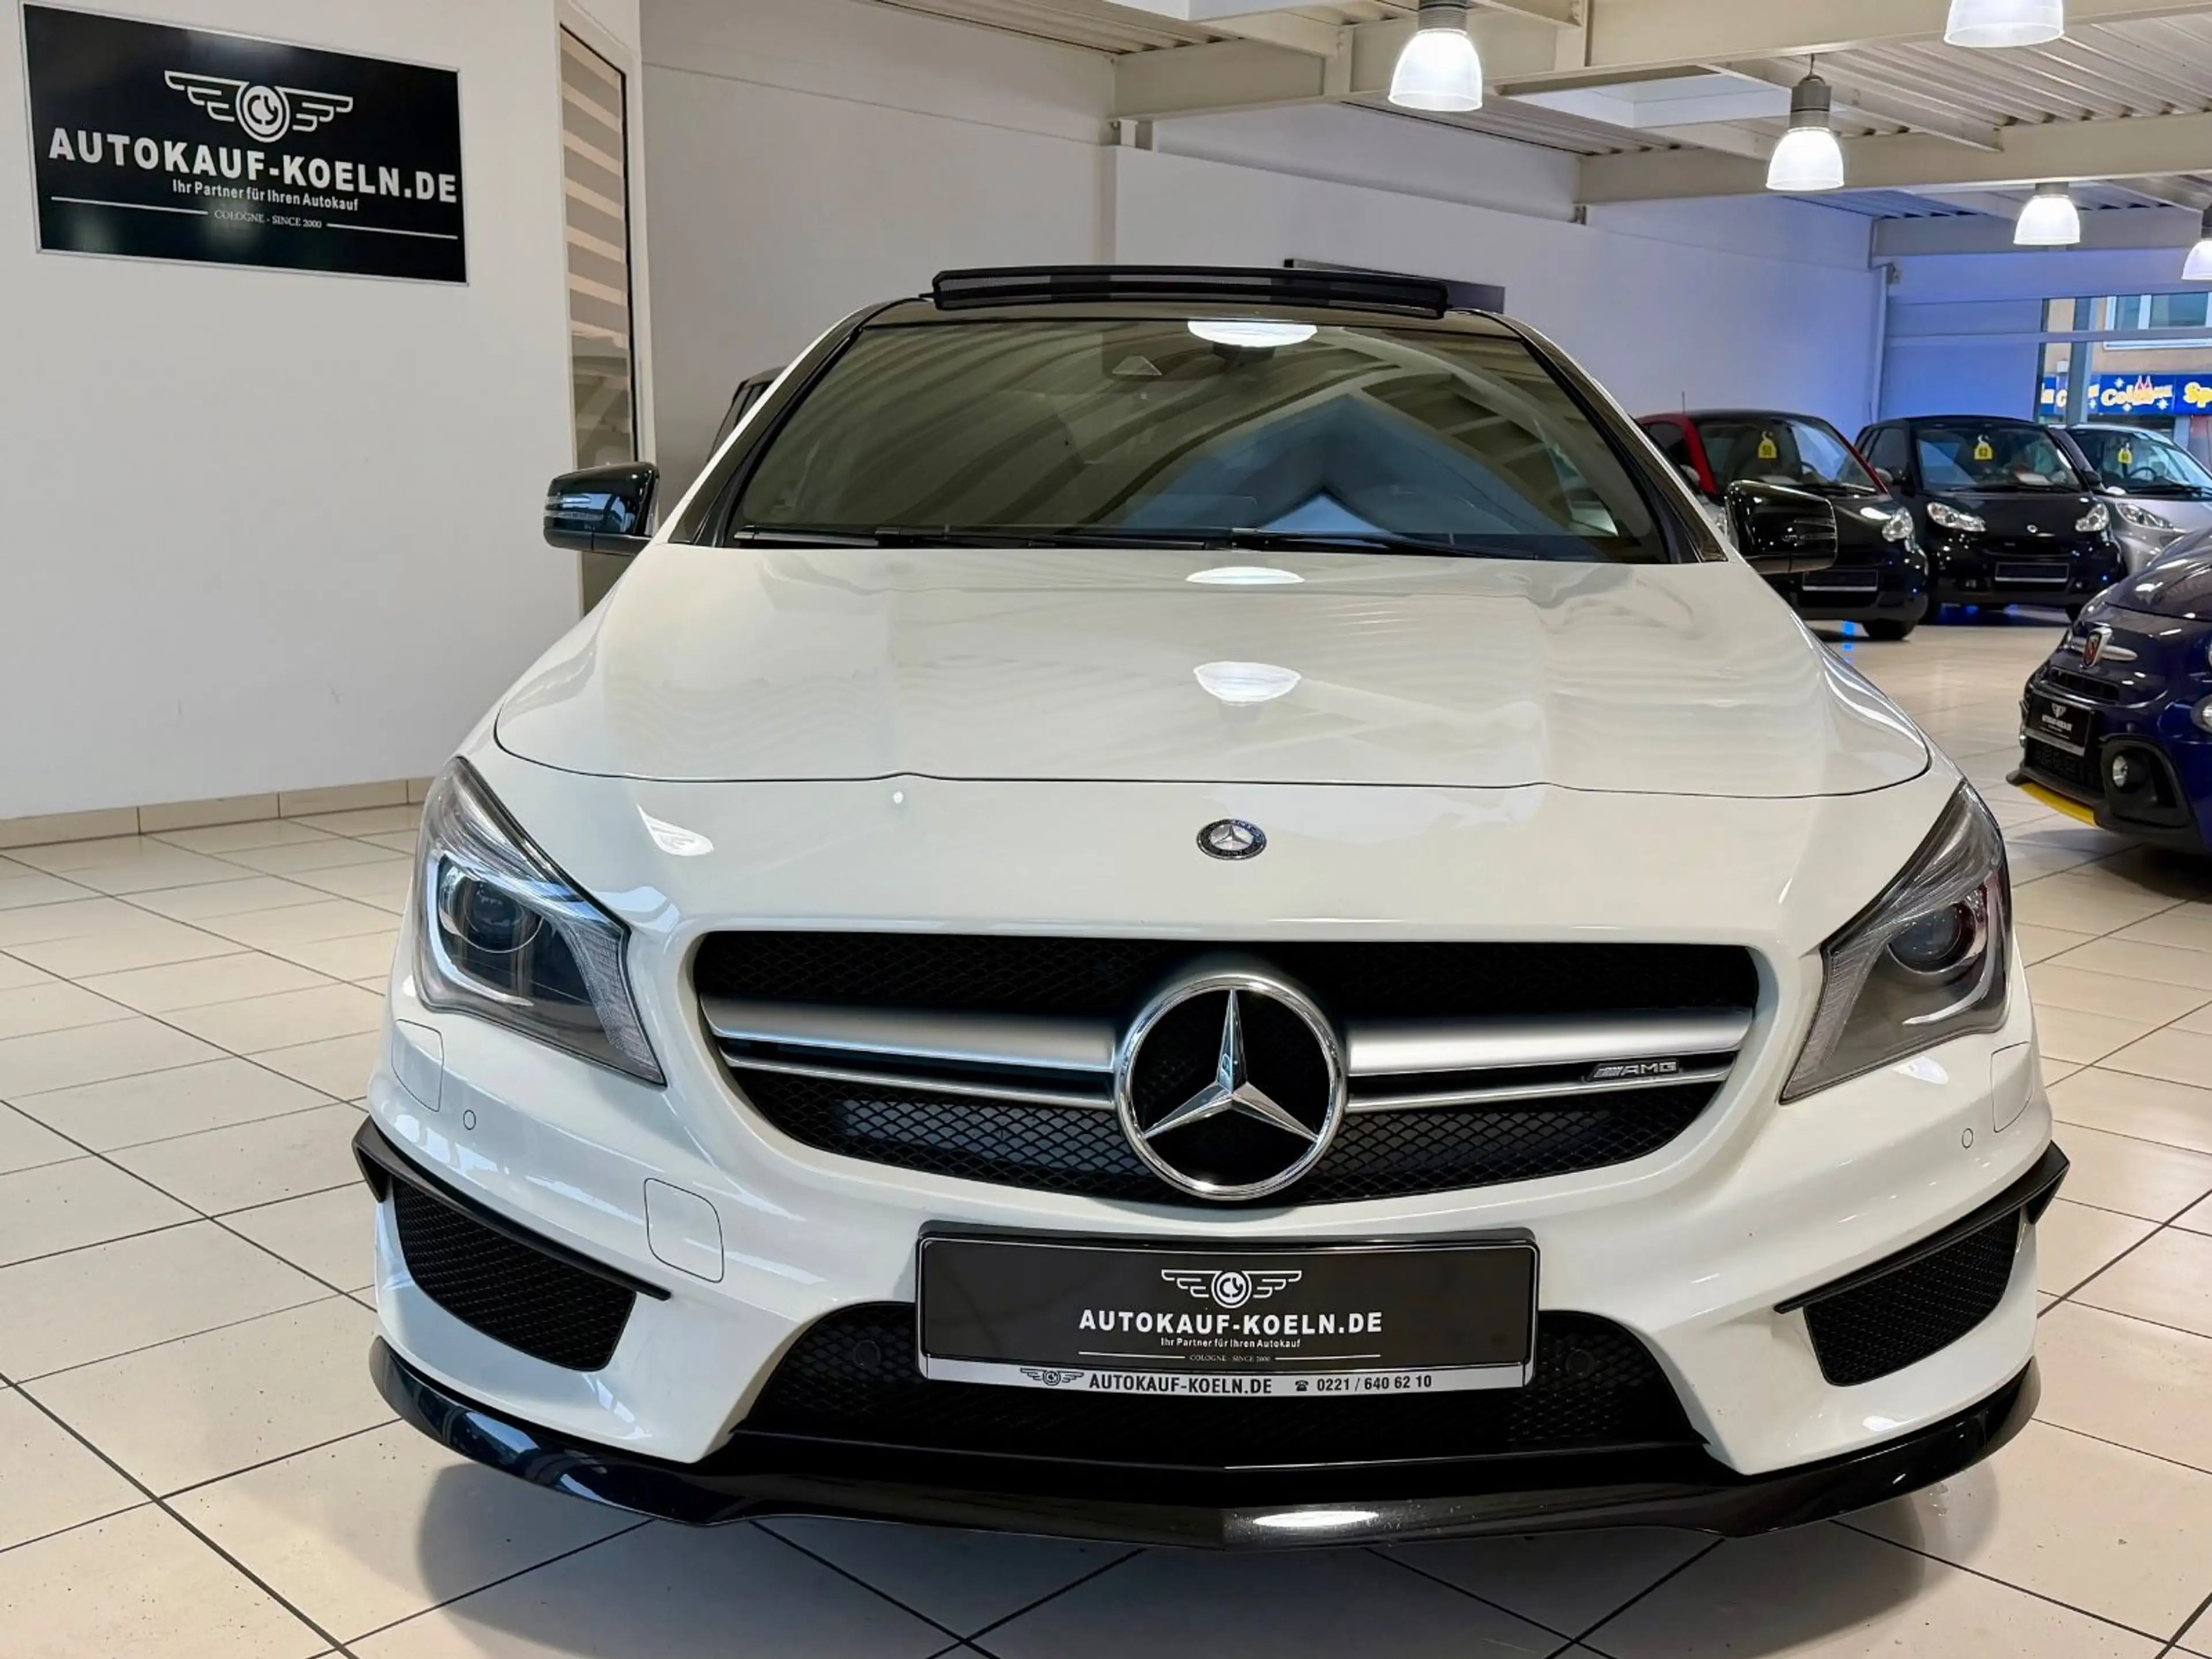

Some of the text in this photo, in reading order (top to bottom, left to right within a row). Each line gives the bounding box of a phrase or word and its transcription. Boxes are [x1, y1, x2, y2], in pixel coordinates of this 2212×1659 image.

[48, 127, 457, 203] AUTOKAUF-KOELN.DE
[173, 179, 358, 211] Ihr Partner für Ihren Autokauf
[214, 210, 265, 223] COLOGNE
[272, 215, 301, 226] SINCE
[303, 219, 322, 228] 2000
[1078, 1309, 1382, 1335] AUTOKAUF-KOELN.DE
[1161, 1337, 1301, 1348] Ihr Partner für Ihren Autokauf
[1089, 1373, 1272, 1394] AUTOKAUF-KOELN.DE
[1317, 1378, 1349, 1391] 0221
[1365, 1377, 1389, 1389] 640
[1395, 1376, 1410, 1389] 62
[1416, 1375, 1432, 1387] 10
